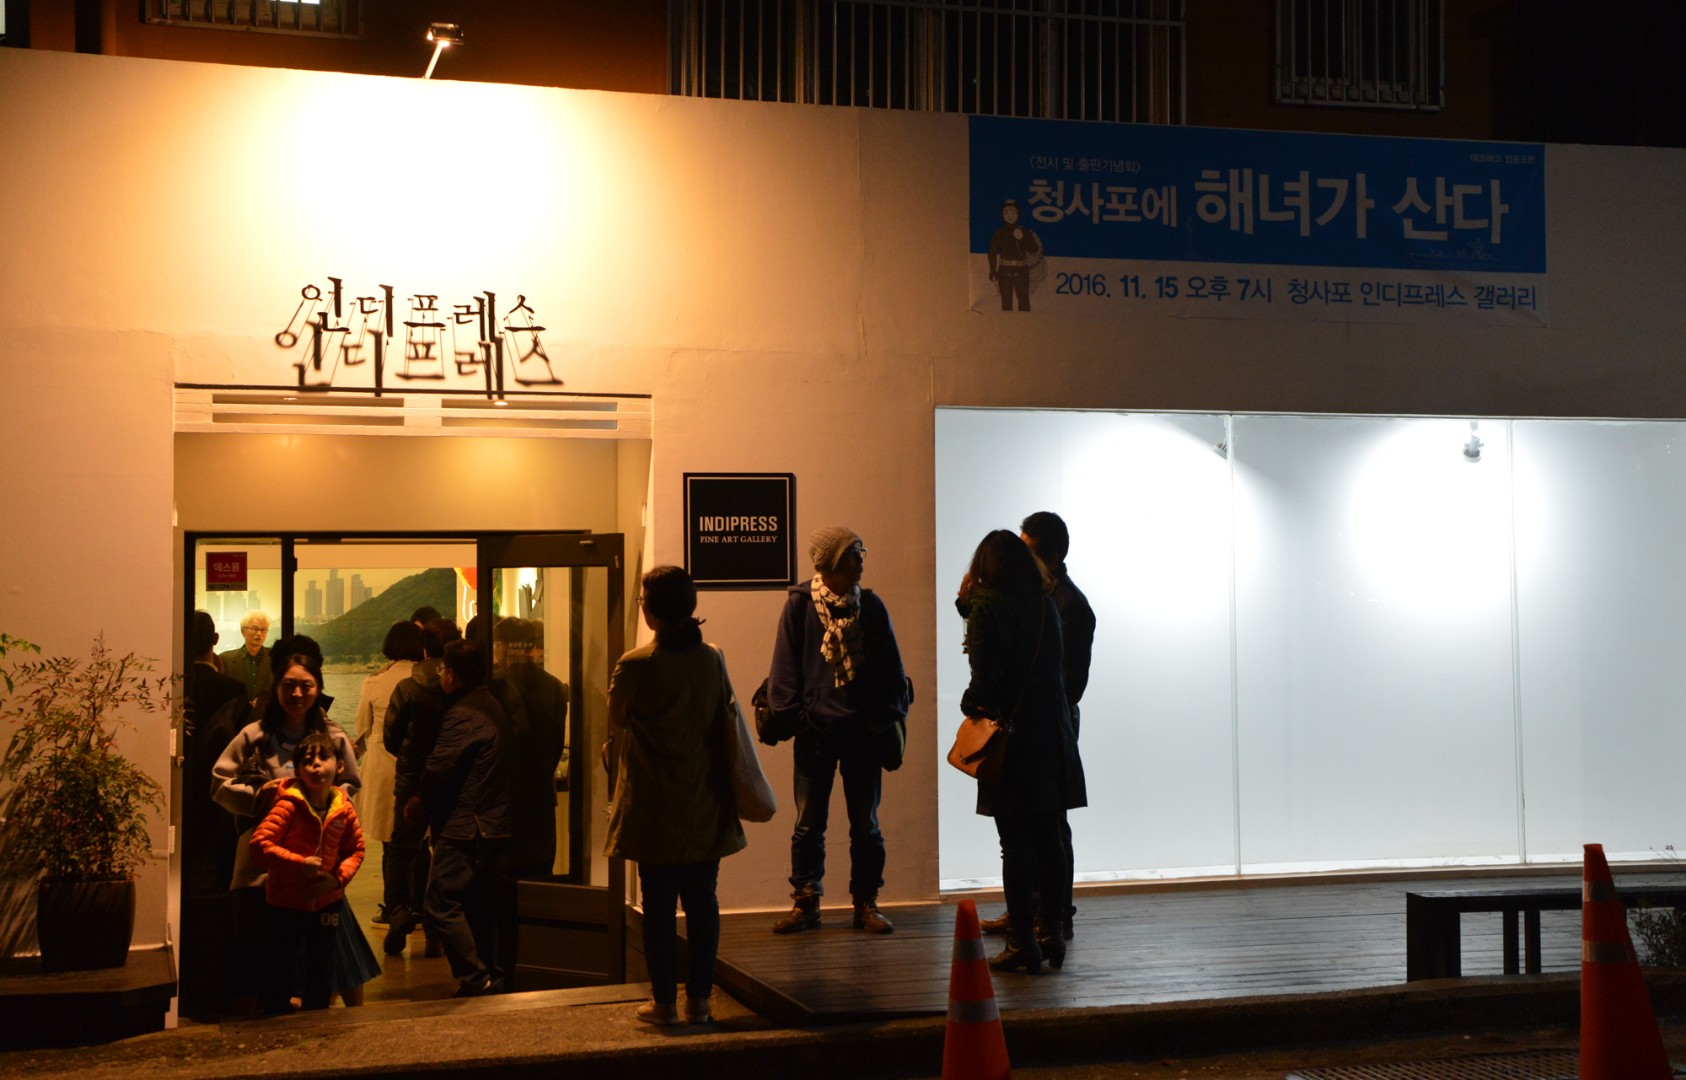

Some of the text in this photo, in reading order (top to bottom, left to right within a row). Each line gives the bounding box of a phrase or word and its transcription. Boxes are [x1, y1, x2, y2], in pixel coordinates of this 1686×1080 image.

[1027, 167, 1510, 245] 청사포에 해녀가 산다
[300, 276, 547, 343] 인디프레스
[1055, 273, 1537, 311] 2016. 11. 15 오후 7시 청사포 인디프레스 갤러리
[699, 516, 778, 532] INDIPRESS
[700, 535, 778, 543] FINE ART GALLERY
